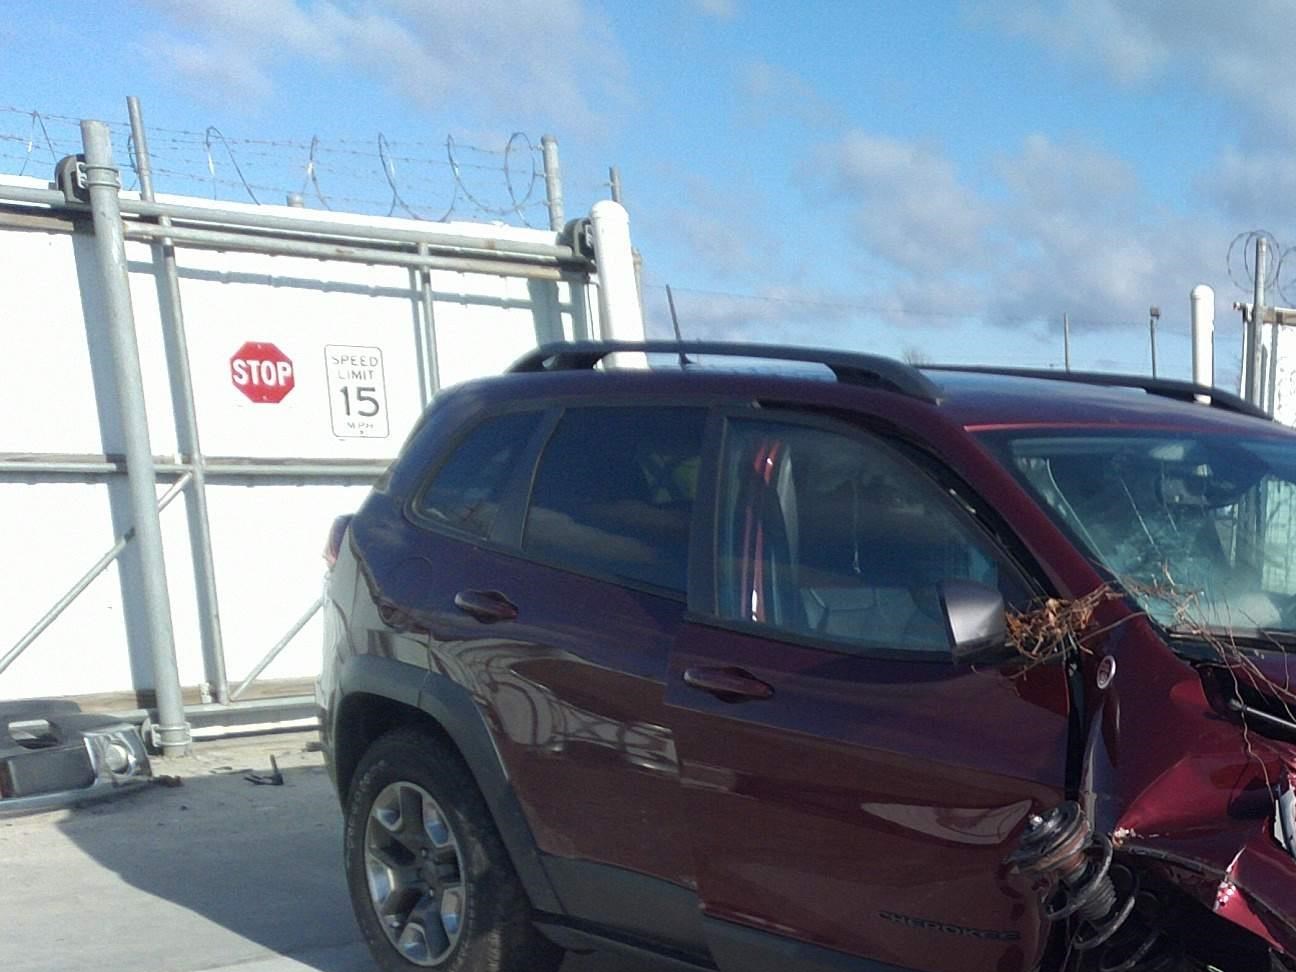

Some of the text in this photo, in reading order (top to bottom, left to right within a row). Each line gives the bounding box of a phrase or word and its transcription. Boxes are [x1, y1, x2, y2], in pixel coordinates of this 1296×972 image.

[331, 355, 379, 367] SPEED
[232, 358, 292, 387] STOP
[338, 370, 374, 380] LIMIT
[340, 386, 380, 416] 15
[346, 421, 374, 429] MPH
